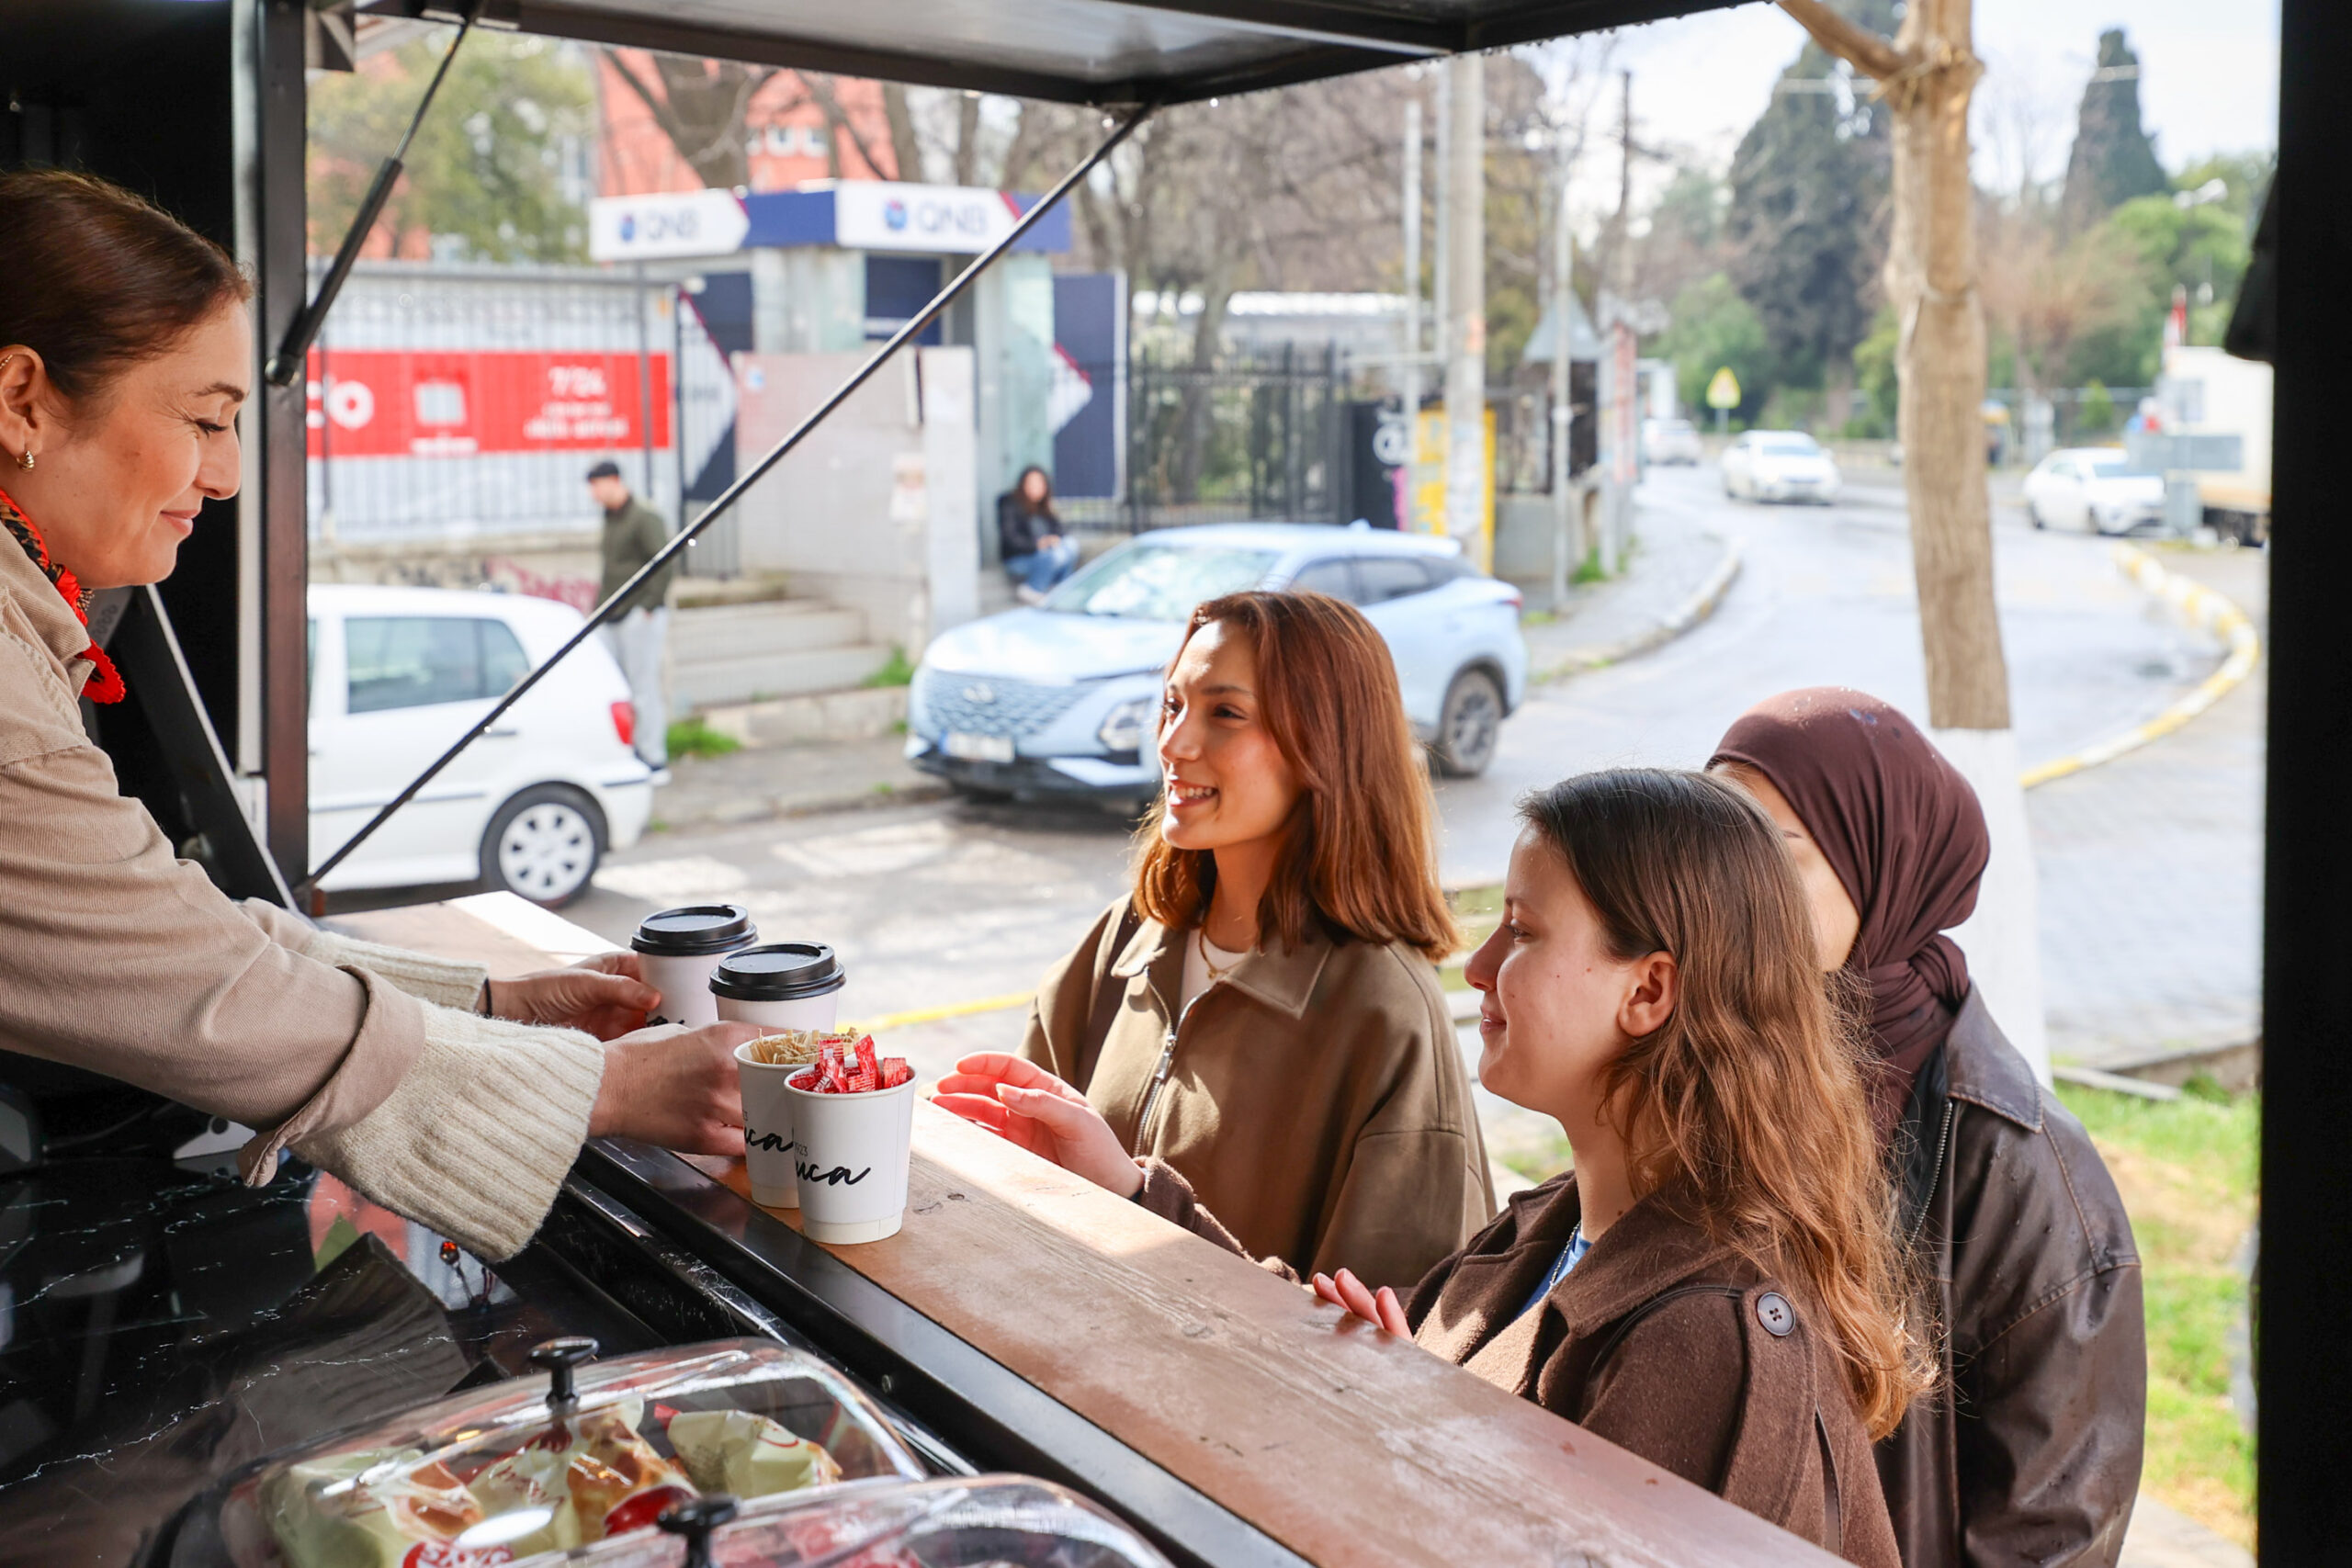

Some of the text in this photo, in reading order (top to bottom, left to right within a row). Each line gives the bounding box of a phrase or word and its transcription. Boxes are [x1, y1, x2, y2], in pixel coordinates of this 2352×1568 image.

[647, 209, 699, 239] QNB
[918, 202, 988, 234] QNB
[796, 1160, 872, 1187] uca
